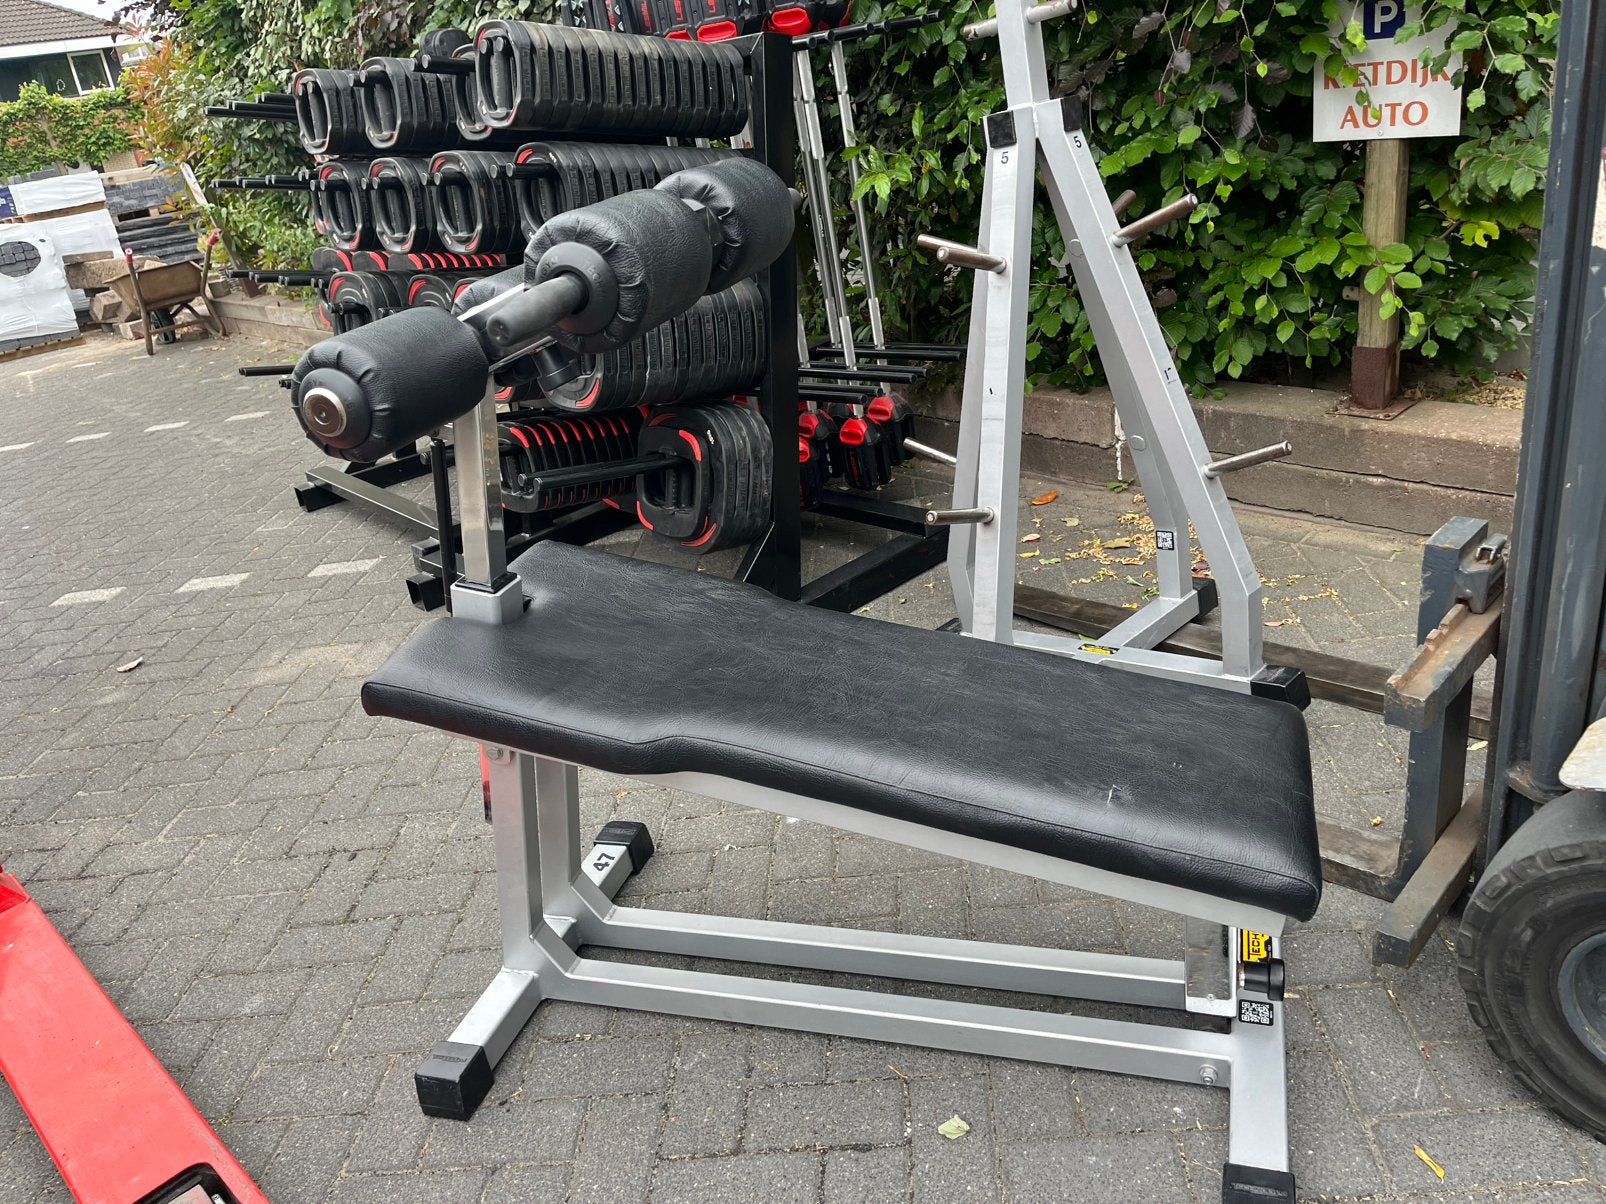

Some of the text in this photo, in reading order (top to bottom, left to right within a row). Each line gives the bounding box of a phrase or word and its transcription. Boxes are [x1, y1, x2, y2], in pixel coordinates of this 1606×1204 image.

[1374, 0, 1398, 33] P
[1323, 57, 1451, 90] RETDIJ
[1340, 100, 1429, 129] AUTO
[1073, 135, 1082, 148] 5
[1001, 151, 1009, 164] 5
[593, 852, 615, 872] 47
[1248, 931, 1262, 957] TECH
